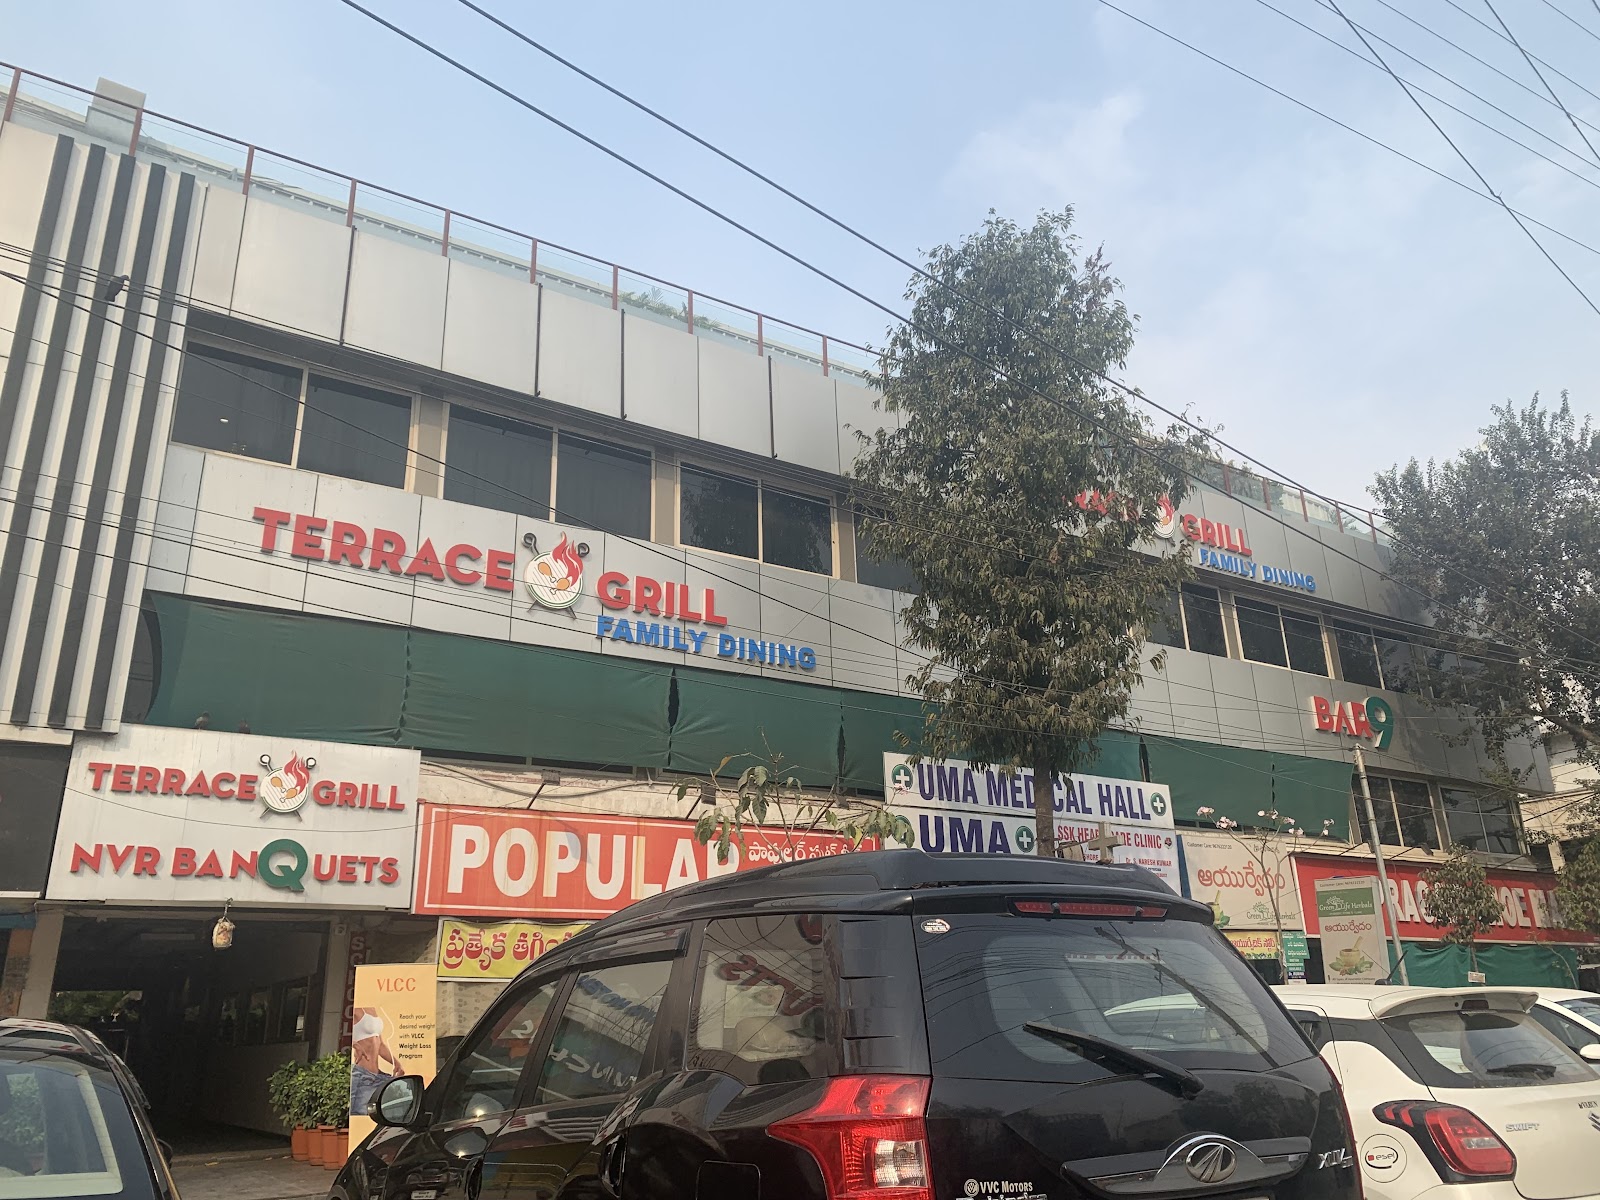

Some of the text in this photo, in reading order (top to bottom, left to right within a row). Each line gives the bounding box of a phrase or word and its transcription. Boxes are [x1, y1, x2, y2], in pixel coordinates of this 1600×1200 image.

[1181, 513, 1252, 556] GRILL
[252, 507, 727, 626] TERRACE GRILL
[1199, 548, 1316, 592] FAMILY DINING
[596, 614, 816, 669] FAMILY DINING
[89, 762, 405, 811] TERRACE GRILL
[917, 763, 1151, 821] UMA MEDCAL HALL
[919, 814, 1012, 855] UMA
[1057, 825, 1075, 841] SSK
[1134, 832, 1162, 849] CLINIC
[70, 838, 399, 892] NVR BANQUETS
[1247, 911, 1261, 920] Green
[377, 977, 416, 992] VLCC
[1505, 1122, 1540, 1132] SWIFT
[980, 1181, 1000, 1194] VVC
